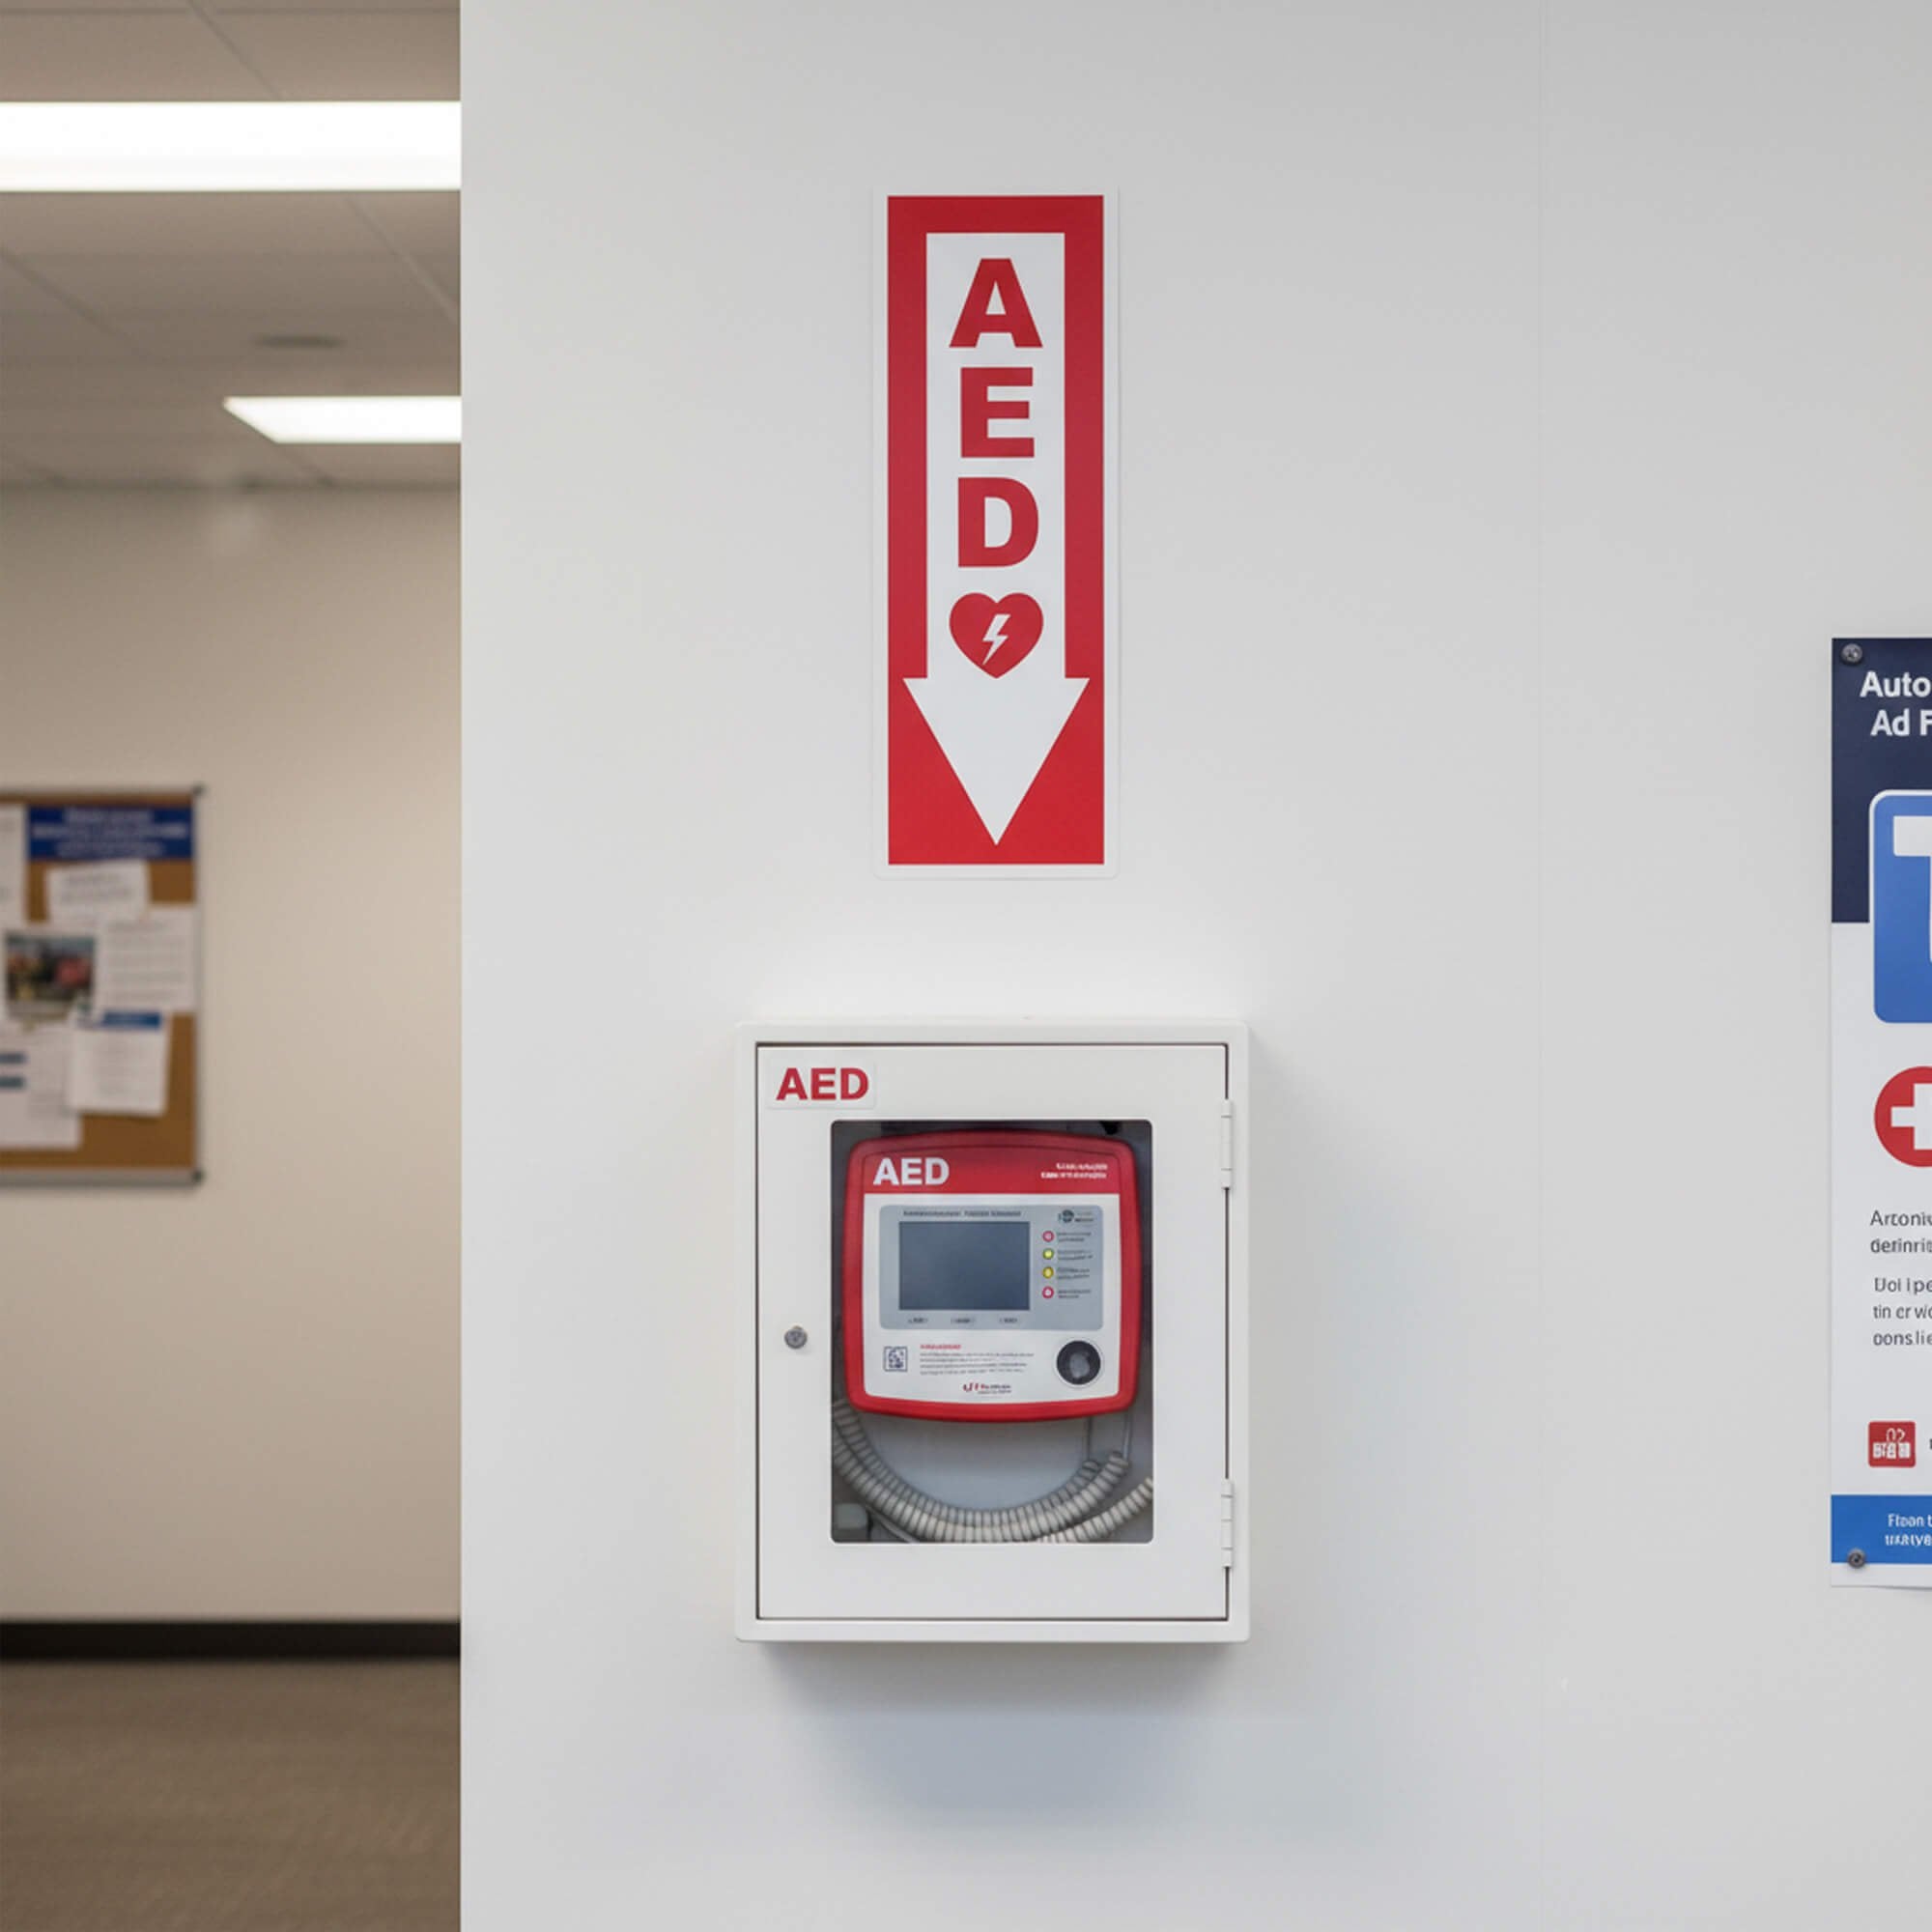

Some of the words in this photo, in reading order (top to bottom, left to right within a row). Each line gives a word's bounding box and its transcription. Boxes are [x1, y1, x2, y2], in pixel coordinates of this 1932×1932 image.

[950, 258, 1042, 568] AED
[1860, 670, 1932, 698] Auto
[1870, 708, 1911, 737] Ad
[776, 1066, 868, 1101] AED
[872, 1157, 950, 1186] AED
